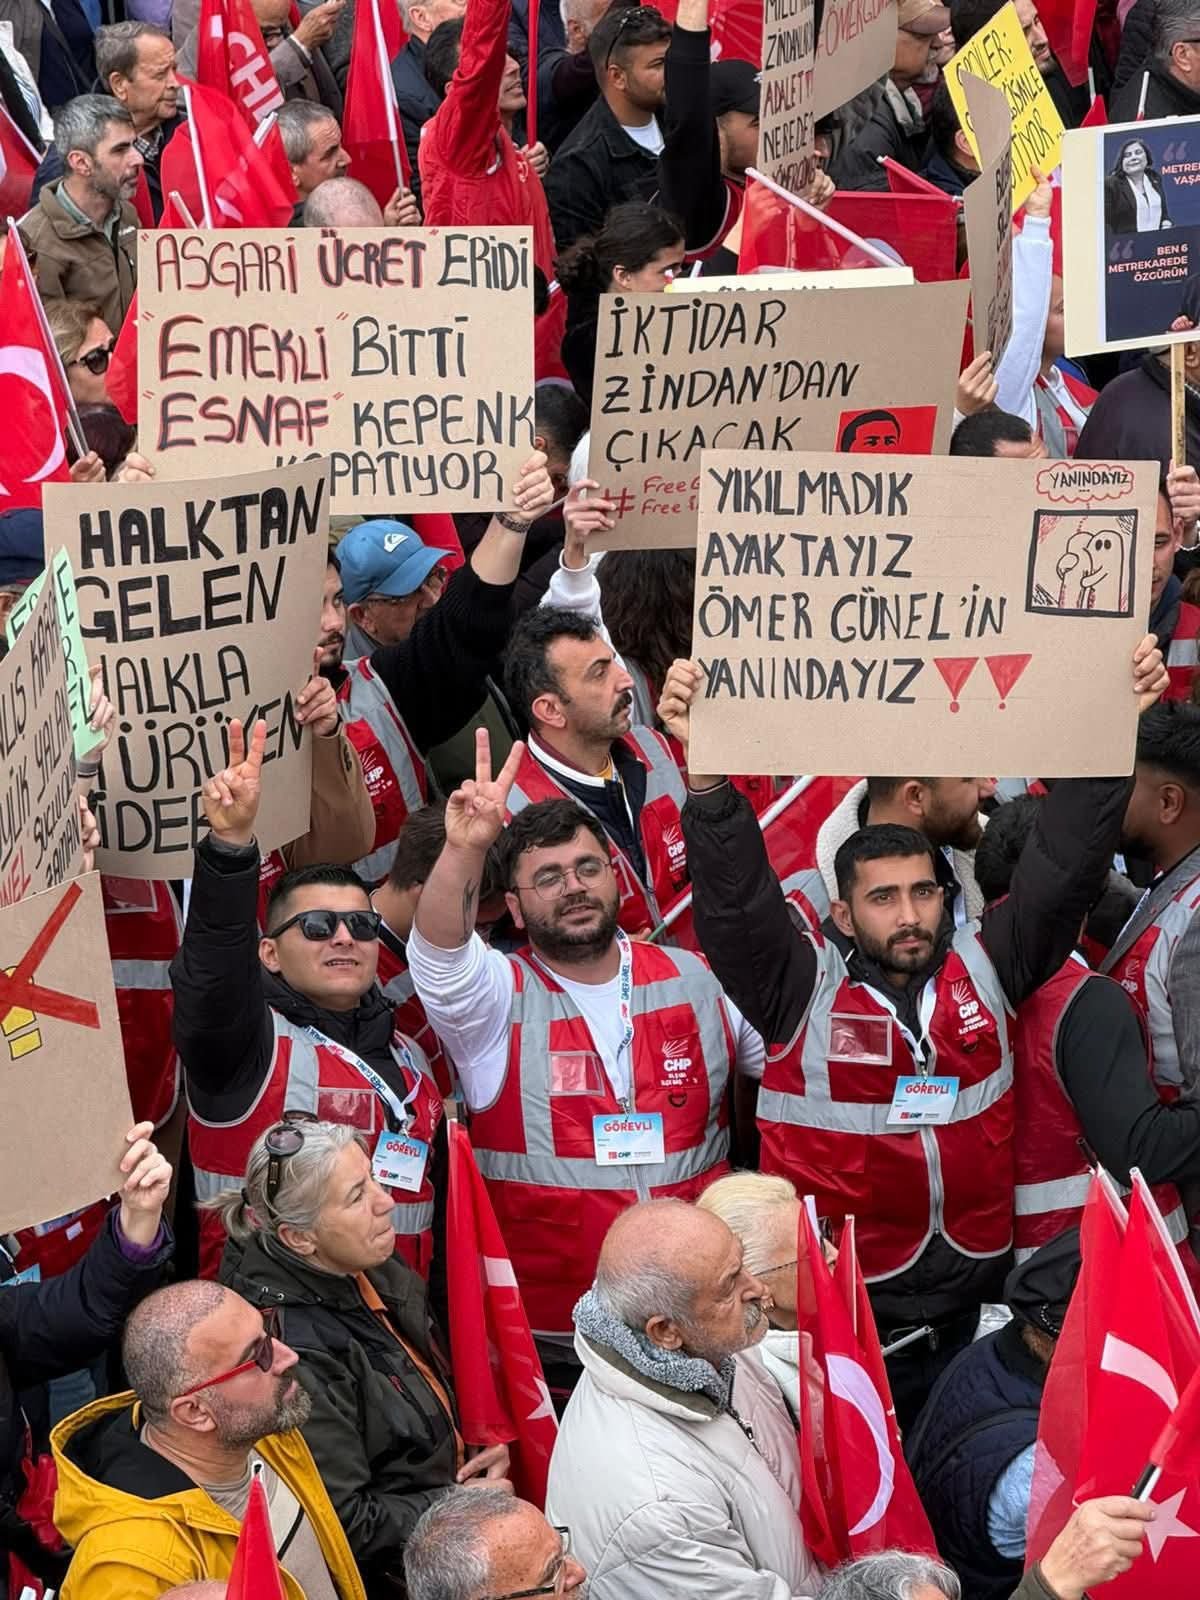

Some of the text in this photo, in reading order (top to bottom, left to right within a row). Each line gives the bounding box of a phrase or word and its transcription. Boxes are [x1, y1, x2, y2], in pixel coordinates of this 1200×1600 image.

[1161, 161, 1200, 175] METRE
[1157, 243, 1189, 256] BEN 6
[1108, 255, 1188, 274] METREKAREDE
[1134, 266, 1188, 283] ÖZGÜRÜM
[604, 296, 786, 358] İKTİDAR
[353, 391, 535, 449] KEPENK
[276, 450, 503, 503] PATIYOR
[642, 475, 687, 494] Free
[1049, 471, 1130, 489] YANINDAYIZ
[707, 466, 913, 517] YIKILMADIK
[641, 498, 681, 515] Free
[79, 477, 326, 570] HALKTAN
[75, 556, 286, 644] GELEN
[700, 584, 1007, 643] ÖMER GÜNEL'İN
[698, 657, 925, 704] YANINDAYIZ
[958, 1001, 980, 1019] CHP
[663, 1057, 693, 1072] CHP
[904, 1081, 950, 1095] GÖREVLİ
[603, 1119, 653, 1133] GÖREVLİ
[386, 1140, 422, 1158] GÖREVLİ
